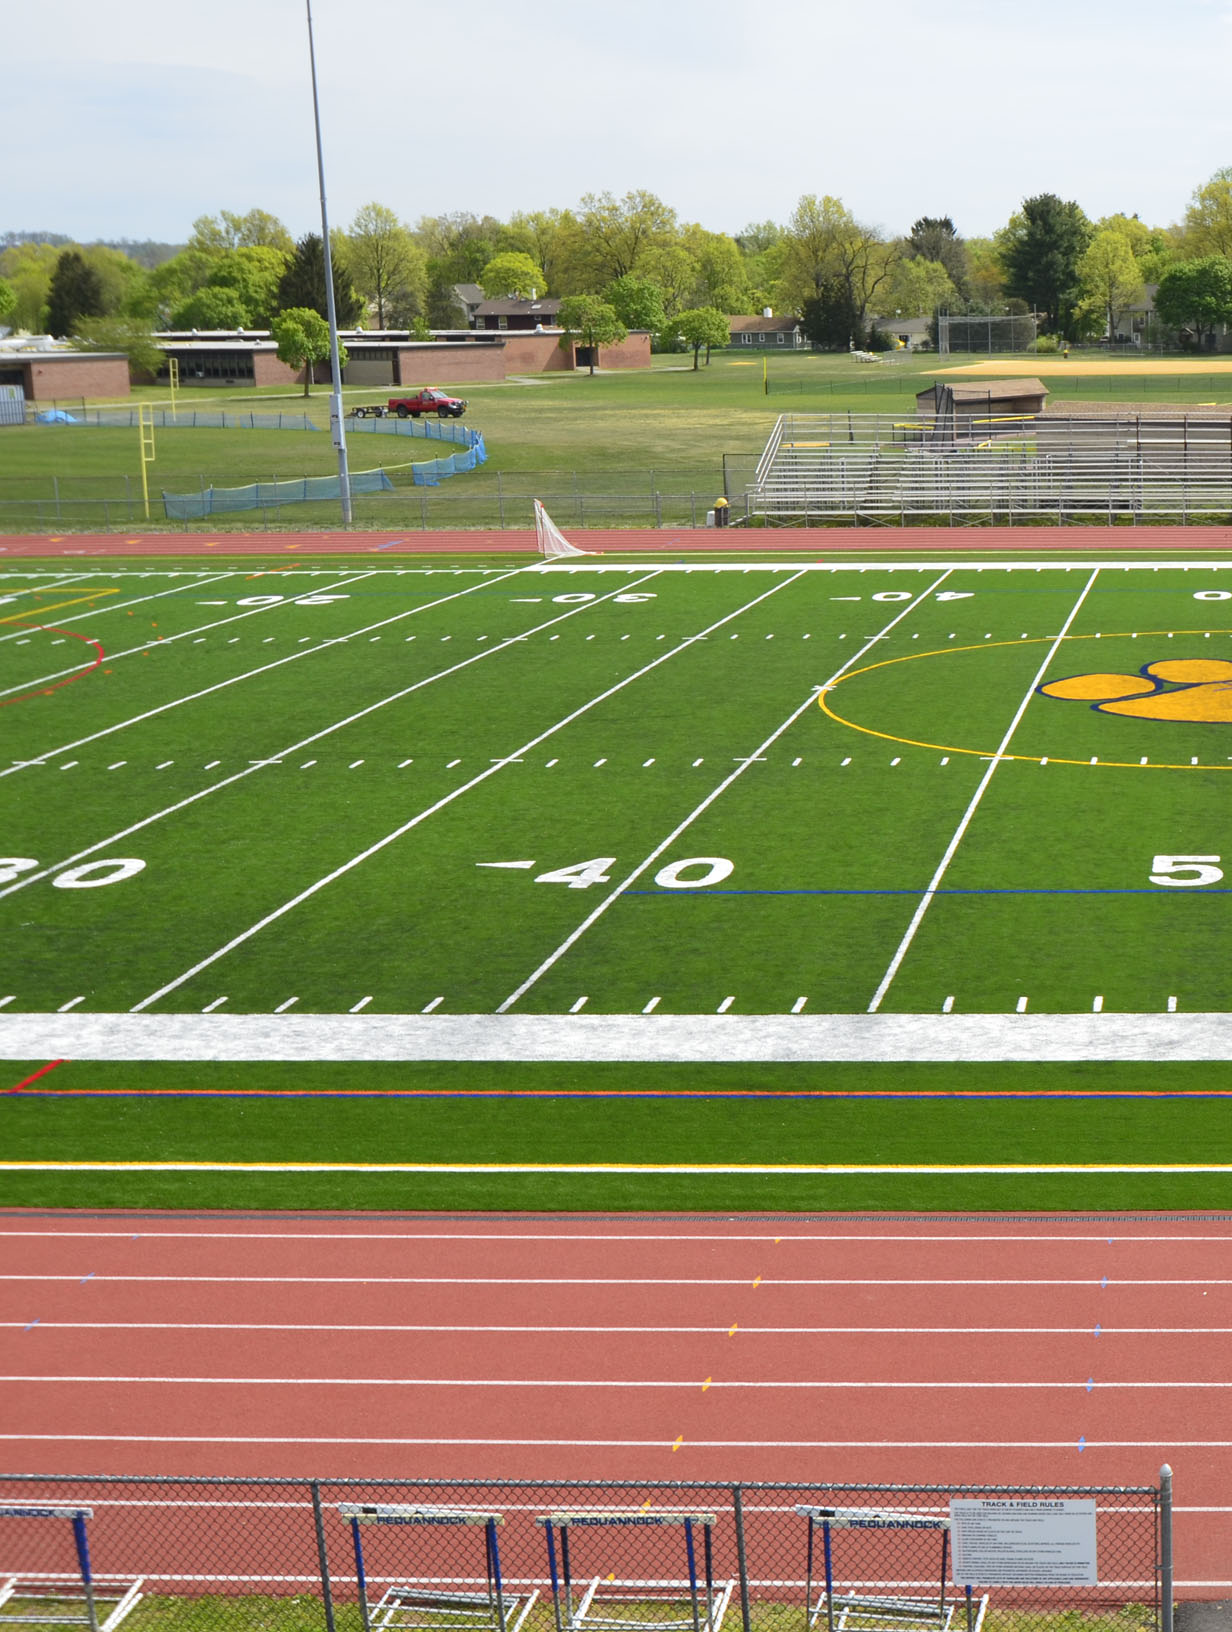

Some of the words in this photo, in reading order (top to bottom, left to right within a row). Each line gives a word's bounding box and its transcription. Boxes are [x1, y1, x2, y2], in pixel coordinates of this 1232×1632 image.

[551, 593, 657, 603] 30
[871, 591, 975, 601] 40
[533, 857, 735, 889] 40
[376, 1516, 467, 1525] PEQUANNOCK
[570, 1516, 664, 1526] PEQUANNOCK
[849, 1519, 943, 1529] PEQUANNOCK
